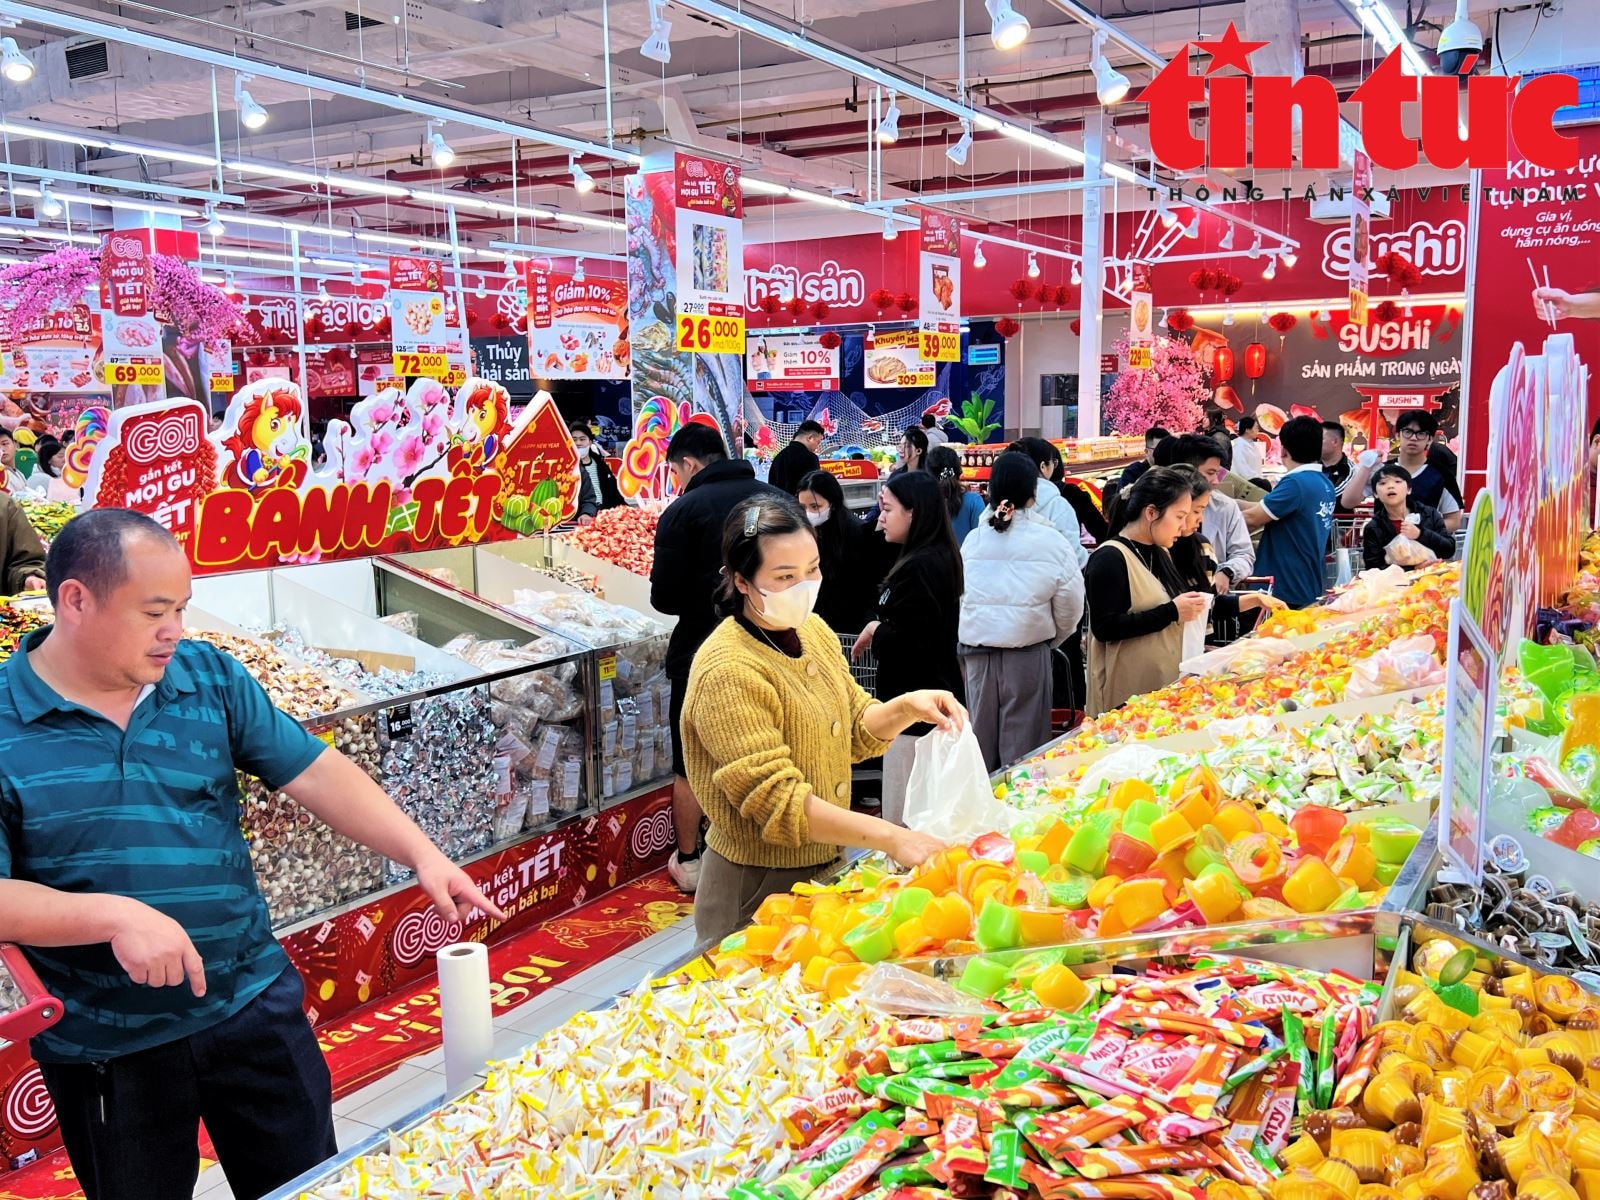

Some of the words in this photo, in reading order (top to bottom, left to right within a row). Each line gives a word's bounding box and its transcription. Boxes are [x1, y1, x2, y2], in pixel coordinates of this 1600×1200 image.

[698, 175, 717, 194] TẾT
[1535, 211, 1557, 223] Gia
[1501, 226, 1534, 239] dụng
[1535, 226, 1552, 236] cụ
[1553, 222, 1569, 234] ăn
[111, 236, 144, 259] GO!
[112, 268, 130, 279] MỌI
[131, 267, 144, 277] GU
[802, 264, 861, 303] sản
[115, 277, 143, 296] TẾT
[554, 280, 586, 303] Giảm
[588, 284, 611, 301] 10%
[486, 341, 522, 362] Thủy
[800, 350, 831, 365] 10%
[505, 362, 530, 381] sản
[1380, 361, 1426, 377] TRONG
[127, 413, 200, 463] GO!
[139, 467, 162, 486] gắn
[163, 460, 183, 475] kết
[516, 452, 559, 484] TẾT
[125, 481, 163, 508] MỌI
[166, 468, 196, 492] GU
[195, 464, 392, 565] BÁNH
[412, 444, 502, 542] TẾT
[517, 835, 566, 889] TẾT
[493, 864, 514, 887] kết
[497, 880, 520, 906] GU
[518, 889, 539, 913] bất
[540, 877, 560, 901] bại
[1089, 1040, 1120, 1062] NATTY
